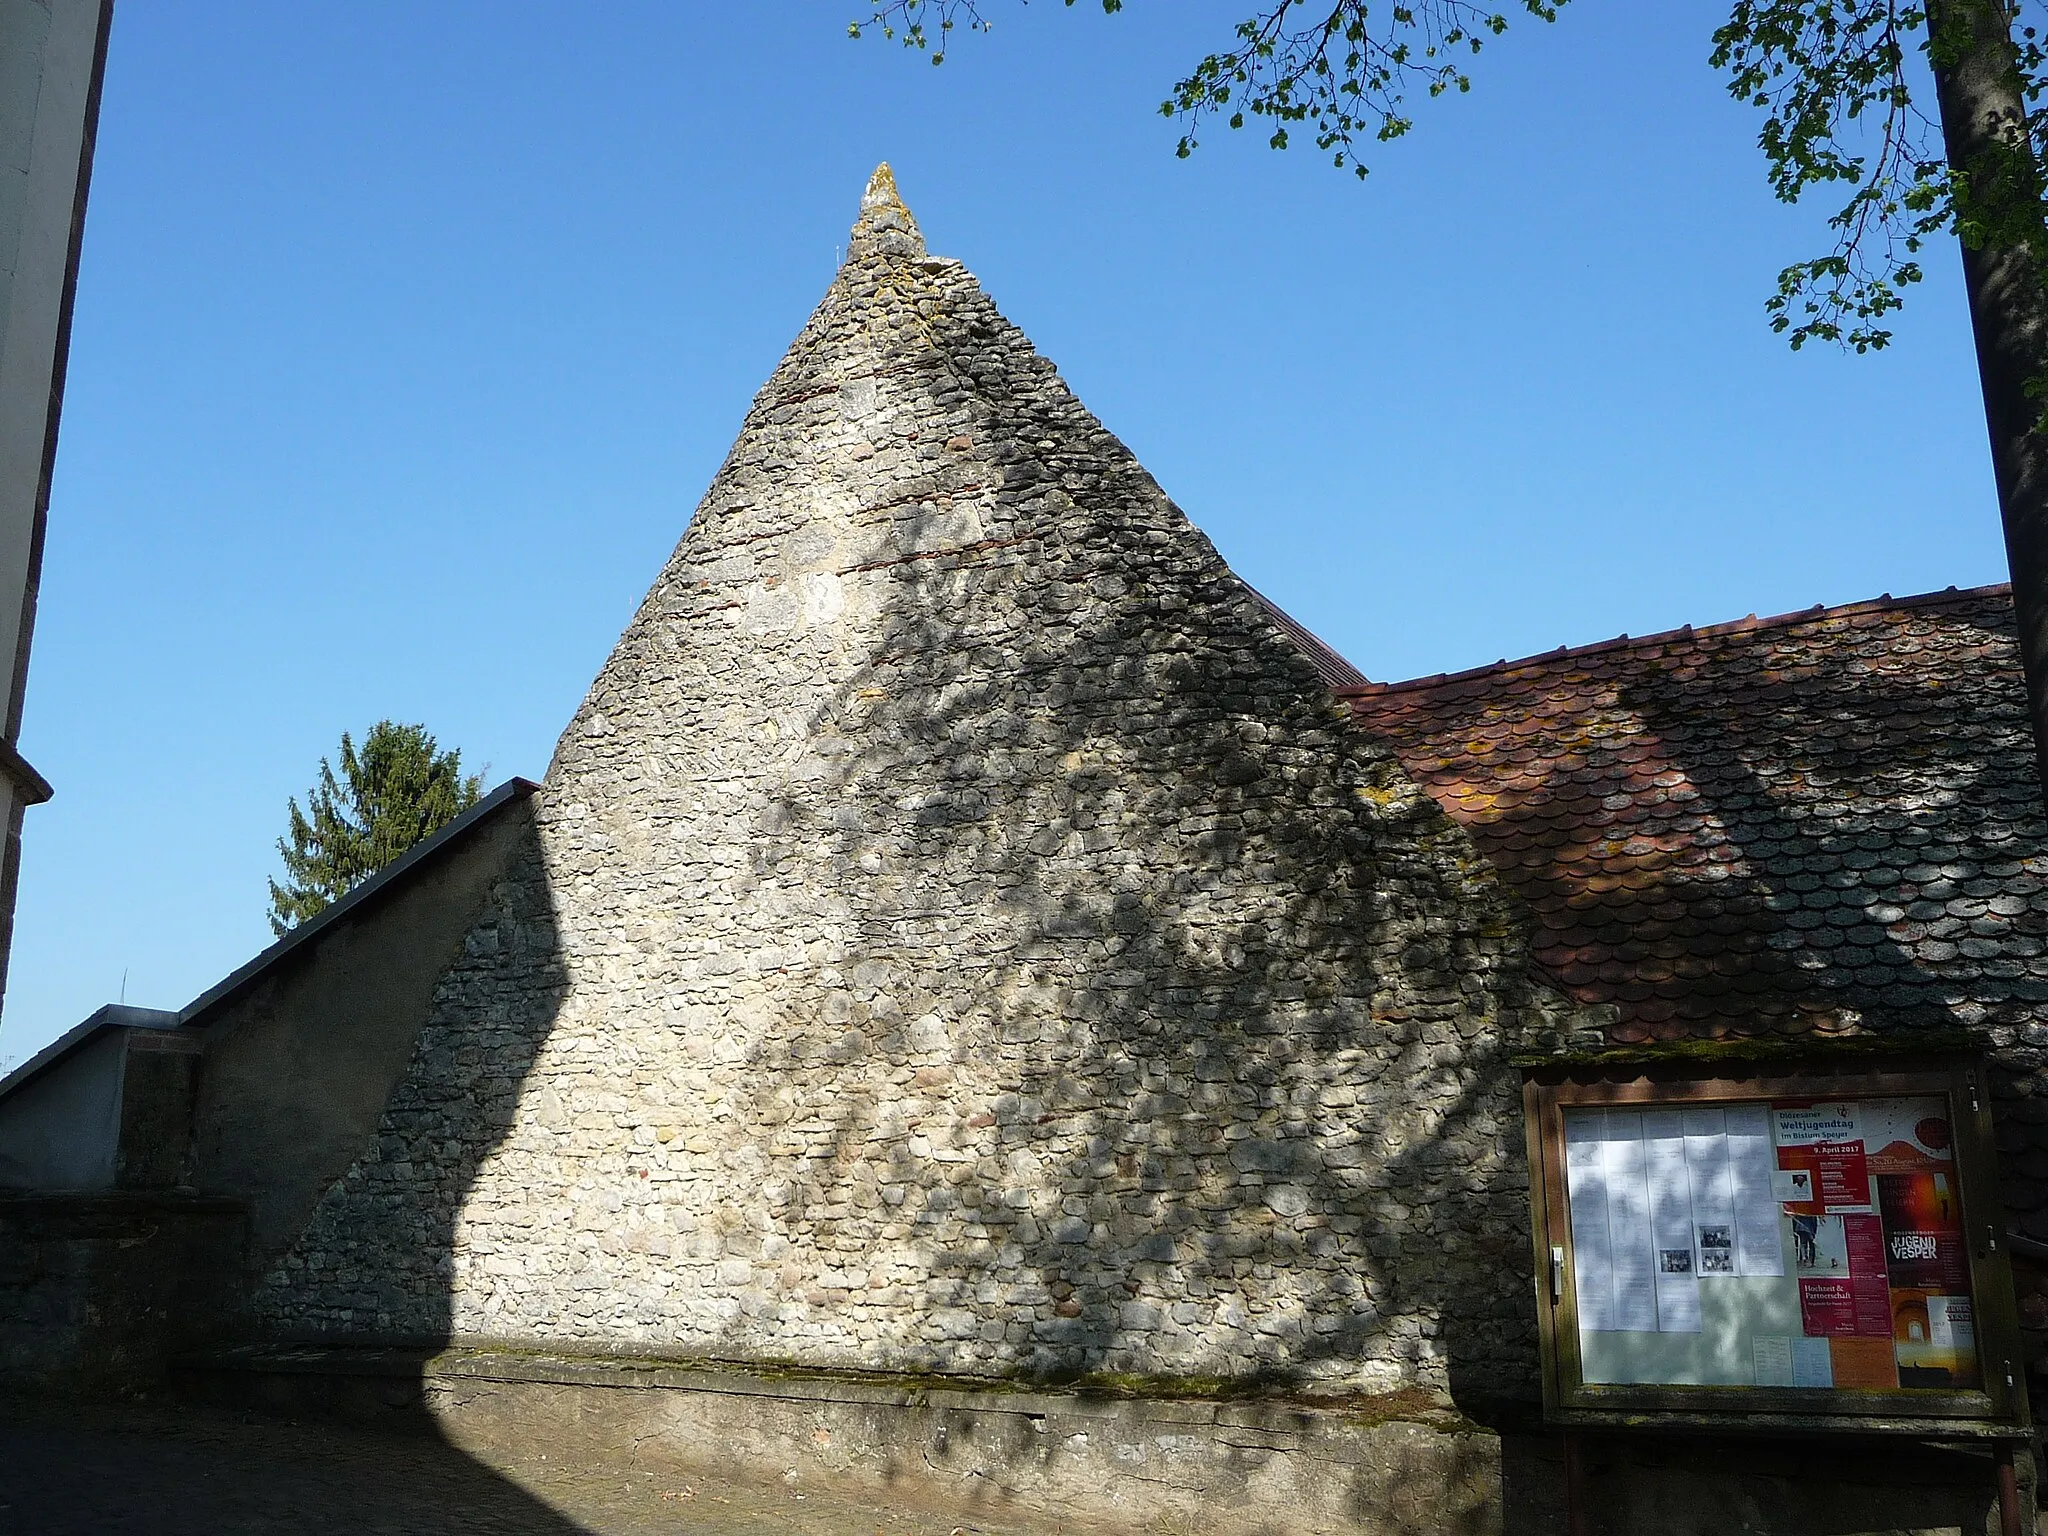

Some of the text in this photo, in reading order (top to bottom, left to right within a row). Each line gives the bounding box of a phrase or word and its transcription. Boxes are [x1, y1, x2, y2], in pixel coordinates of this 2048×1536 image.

[1780, 1120, 1854, 1131] Weltjugendtag
[1822, 1131, 1848, 1140] Speyer
[1822, 1146, 1840, 1154] April
[1891, 1235, 1937, 1248] JUGEND
[1892, 1246, 1937, 1259] VESPER
